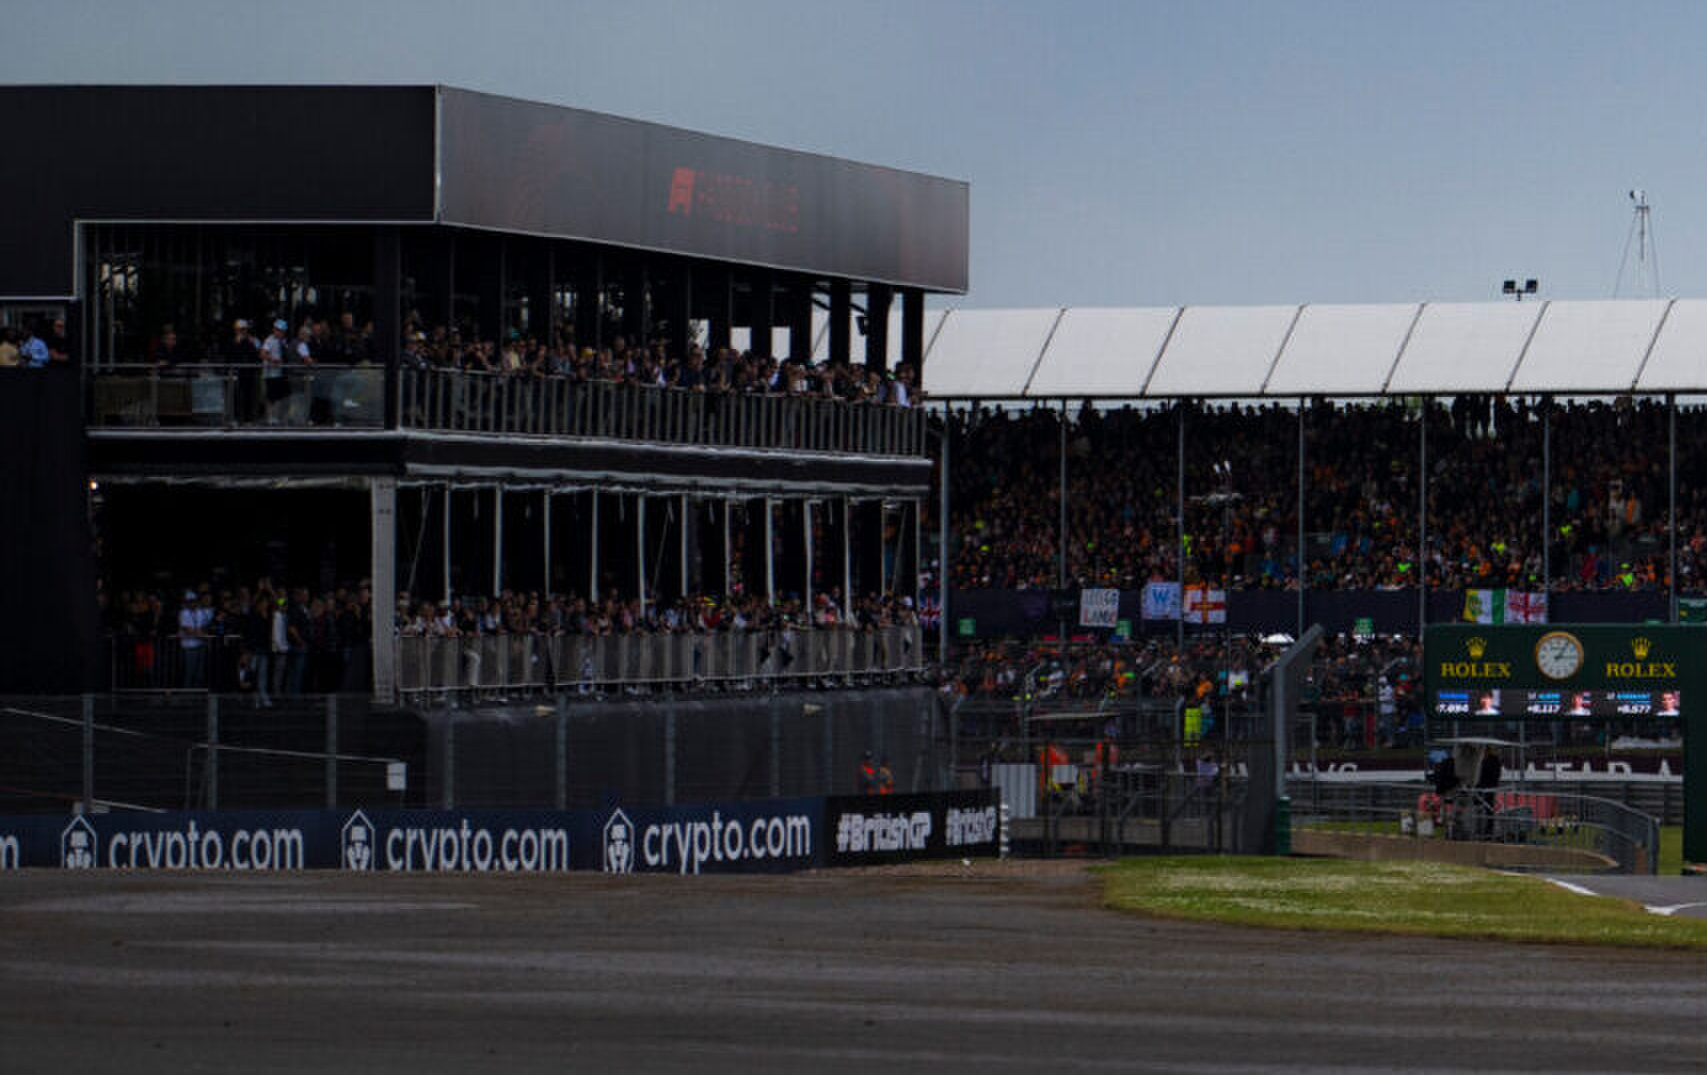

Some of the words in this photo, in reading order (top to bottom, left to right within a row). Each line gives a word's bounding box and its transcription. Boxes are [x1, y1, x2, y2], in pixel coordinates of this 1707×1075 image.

[1440, 662, 1512, 678] ROLEX
[1605, 662, 1677, 678] ROLEX
[108, 819, 304, 870] crypto.com
[386, 818, 569, 872] crypto.com
[642, 811, 812, 875] crypto.com
[836, 812, 932, 853] #BritishGP
